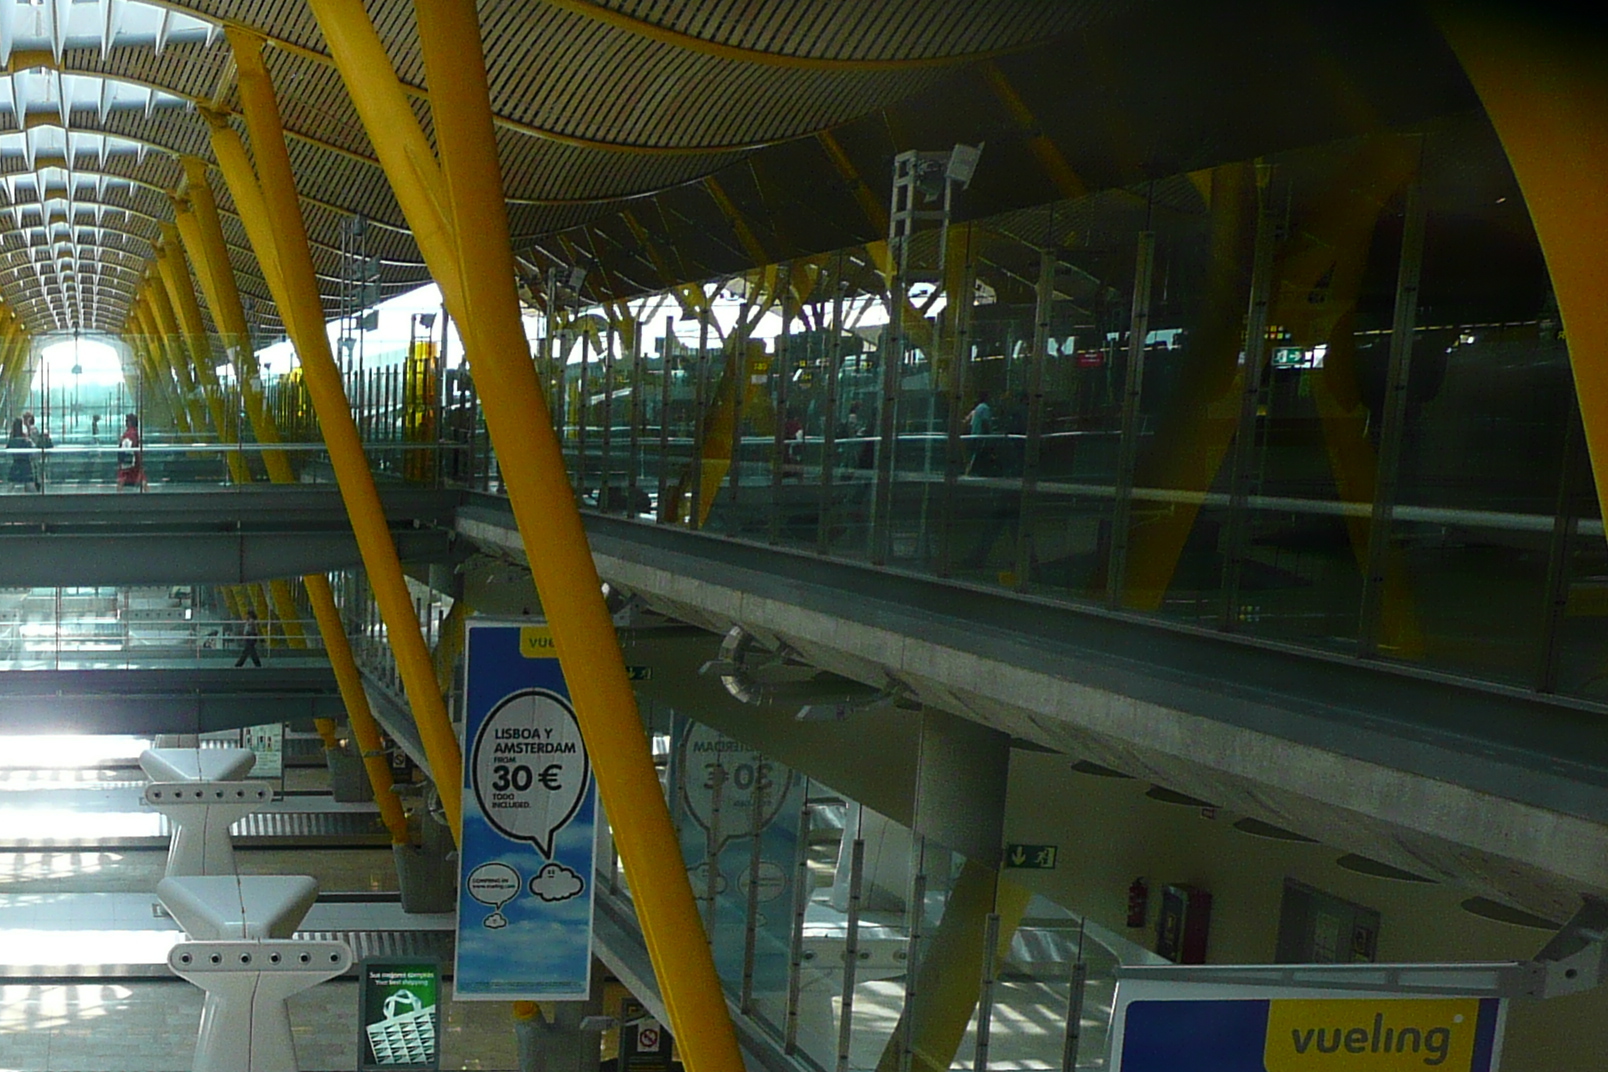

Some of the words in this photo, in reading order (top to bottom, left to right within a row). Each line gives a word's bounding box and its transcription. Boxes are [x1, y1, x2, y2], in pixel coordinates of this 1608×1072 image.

[495, 728, 540, 739] LISBOA
[544, 728, 553, 739] Y
[494, 743, 576, 754] AMSTERDAM
[1292, 1012, 1450, 1066] vueling
